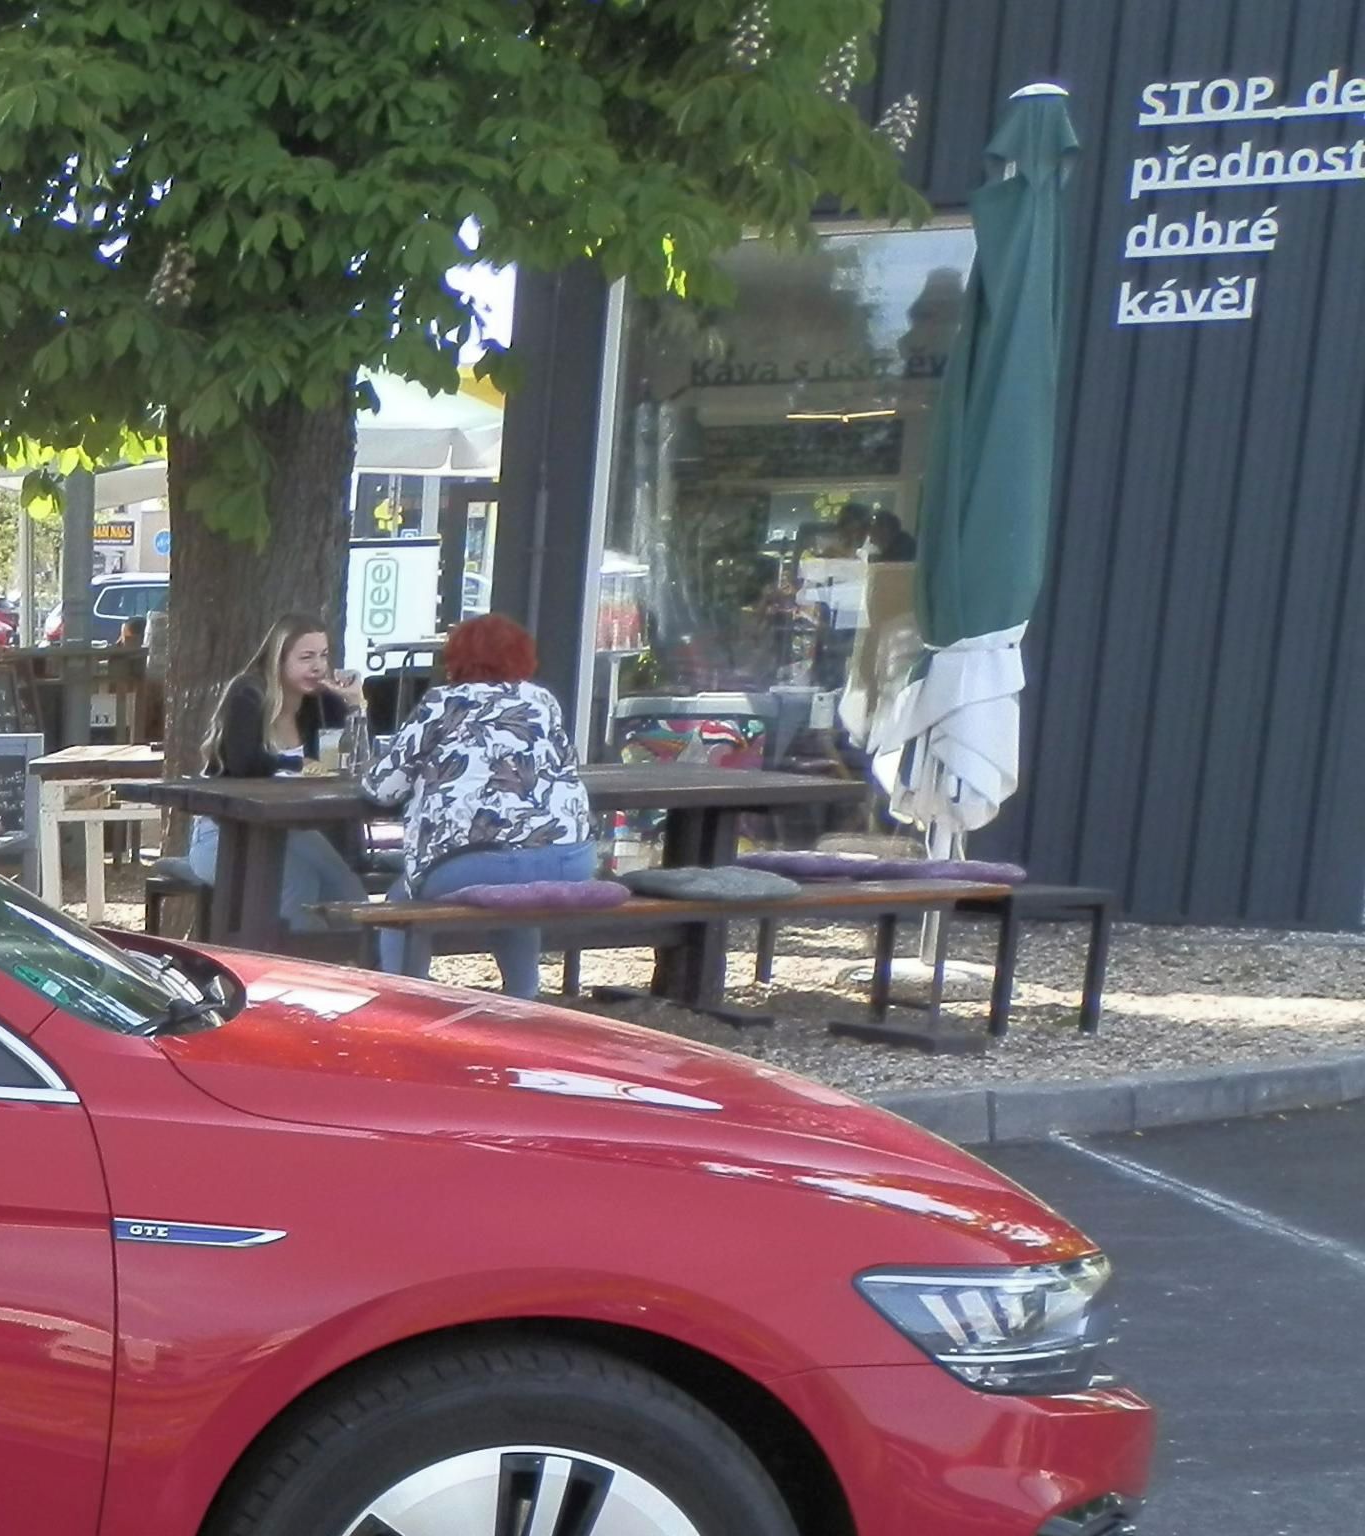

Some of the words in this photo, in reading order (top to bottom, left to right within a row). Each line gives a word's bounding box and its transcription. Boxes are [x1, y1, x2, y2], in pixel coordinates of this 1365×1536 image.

[1140, 76, 1287, 122] STOP,
[1305, 69, 1365, 119] de
[1125, 206, 1279, 258] dobré
[129, 1224, 169, 1238] GTE
